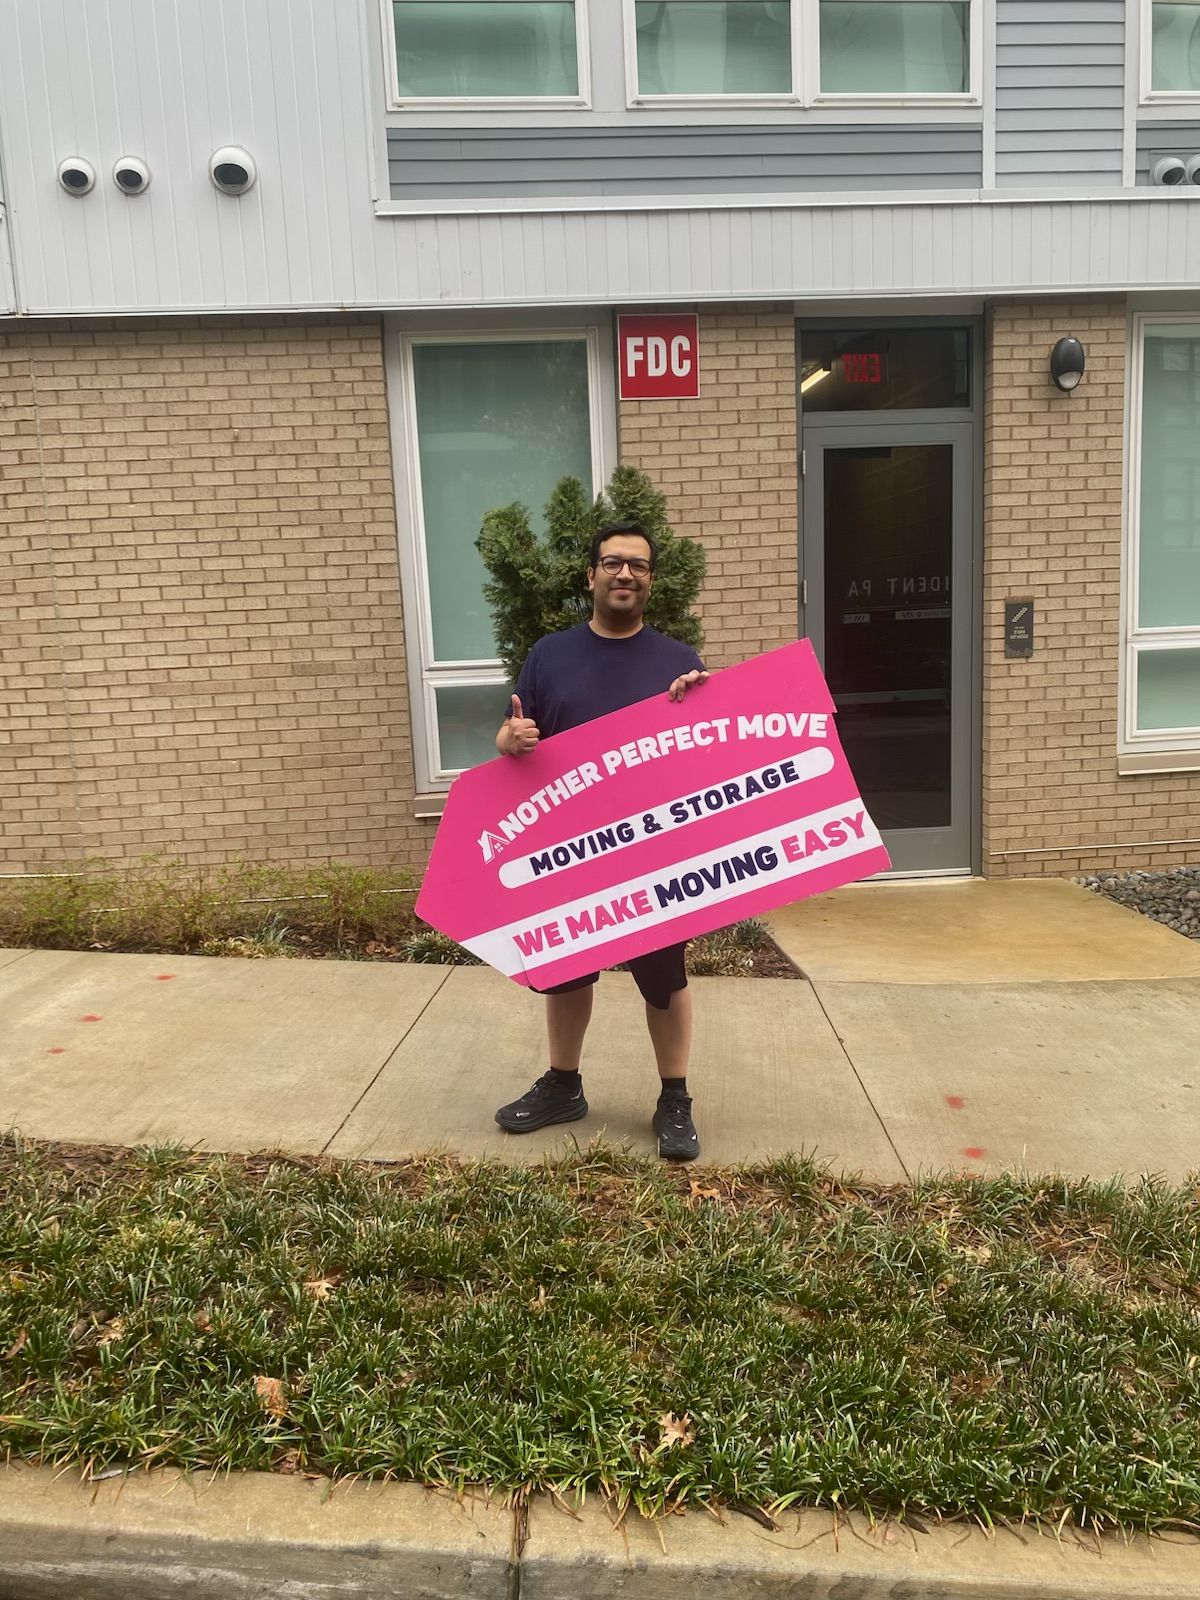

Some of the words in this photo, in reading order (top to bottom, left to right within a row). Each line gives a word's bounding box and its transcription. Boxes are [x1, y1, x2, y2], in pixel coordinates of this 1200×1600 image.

[626, 335, 691, 377] FDC
[477, 761, 603, 864] ANOTHER
[602, 718, 731, 776] PERFECT
[737, 712, 828, 740] MOVE
[529, 821, 635, 876] MOVING
[642, 813, 663, 833] &
[669, 760, 799, 825] STORAGE
[512, 919, 564, 957] WE
[565, 889, 655, 940] MAKE
[653, 845, 778, 908] MOVING
[782, 810, 866, 863] EASY
